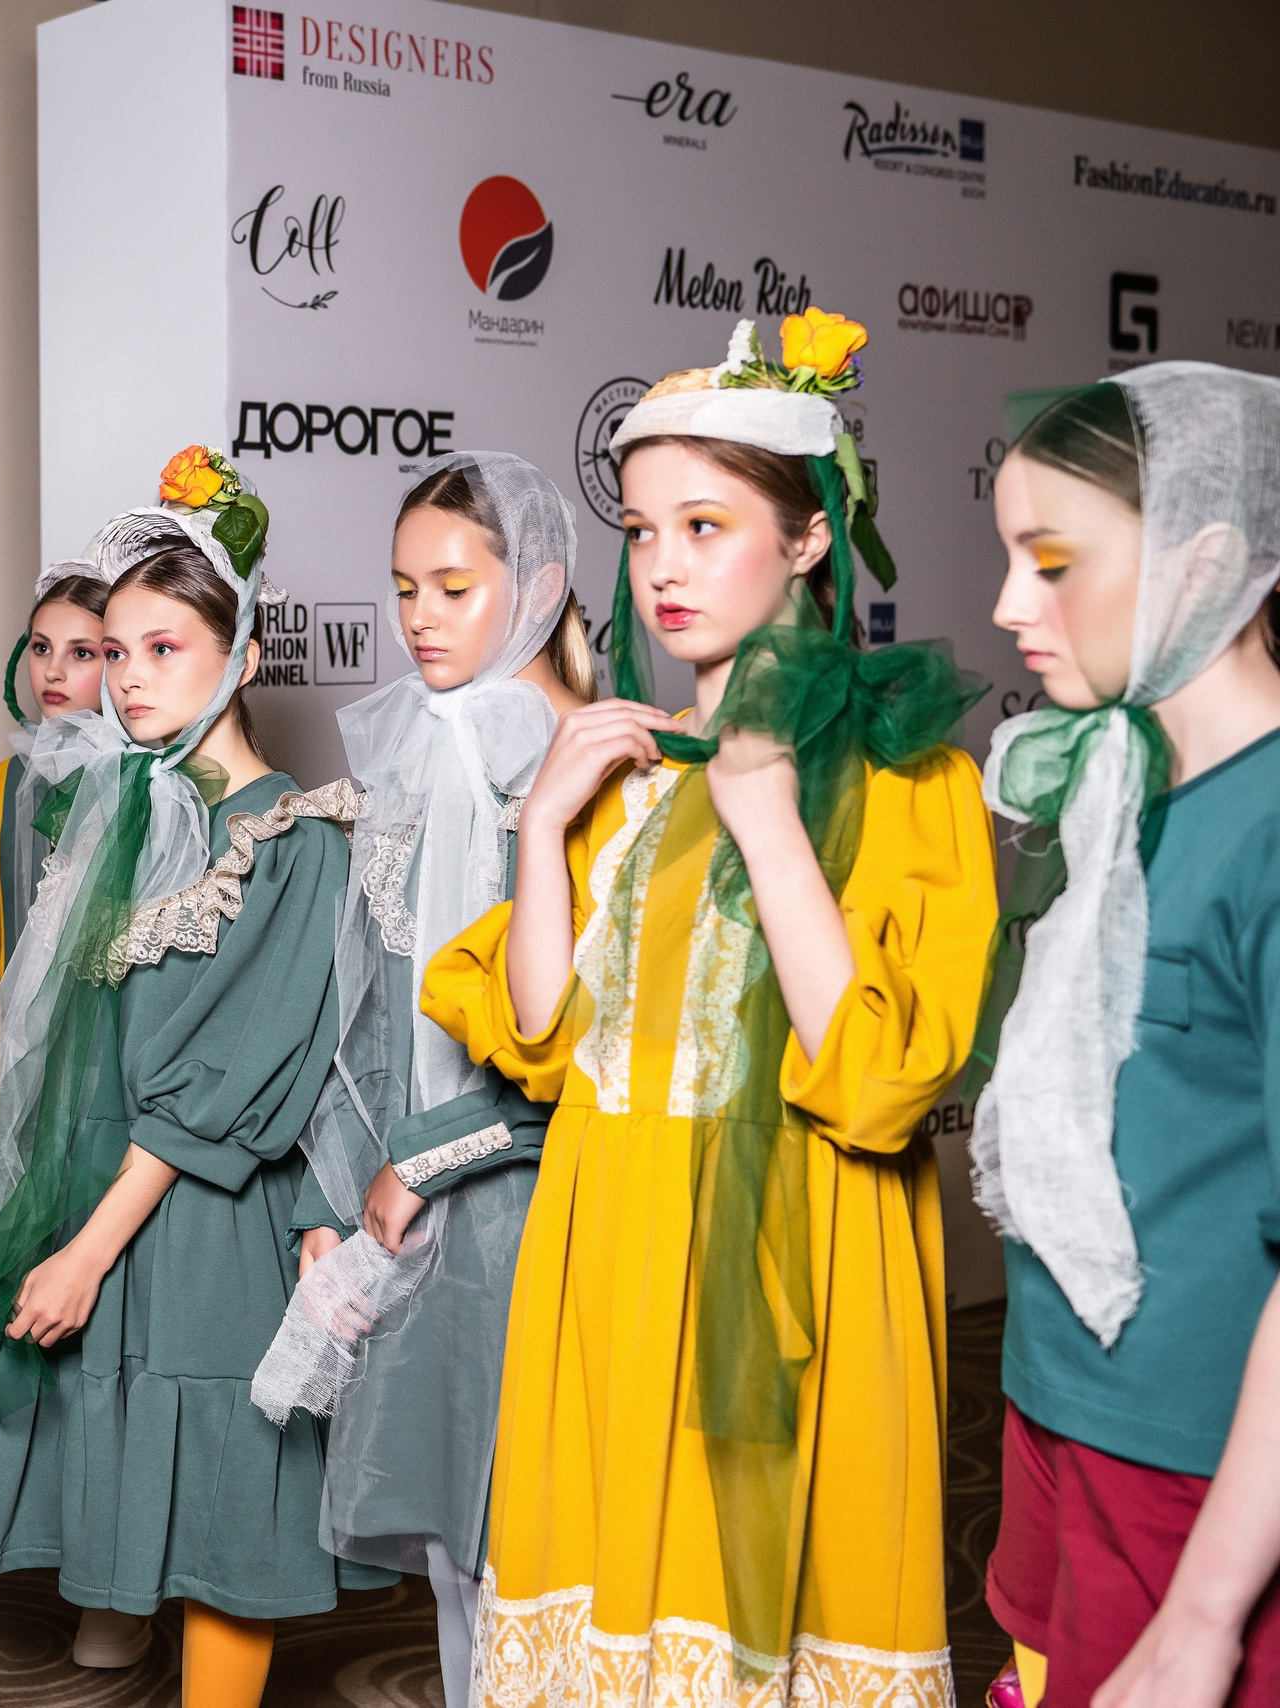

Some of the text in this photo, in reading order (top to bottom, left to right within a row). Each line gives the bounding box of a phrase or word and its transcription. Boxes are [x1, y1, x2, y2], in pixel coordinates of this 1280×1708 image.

[301, 16, 494, 85] DESIGNERS
[302, 66, 391, 97] from Russia
[612, 72, 738, 127] era
[843, 100, 957, 163] Radisson
[1073, 154, 1277, 216] FashionEducation.ru
[654, 247, 811, 316] Melon Rich
[468, 309, 544, 338] Мандарин
[1226, 317, 1269, 349] NEW
[232, 400, 454, 459] ДОРОГОЕ
[323, 622, 369, 668] WF
